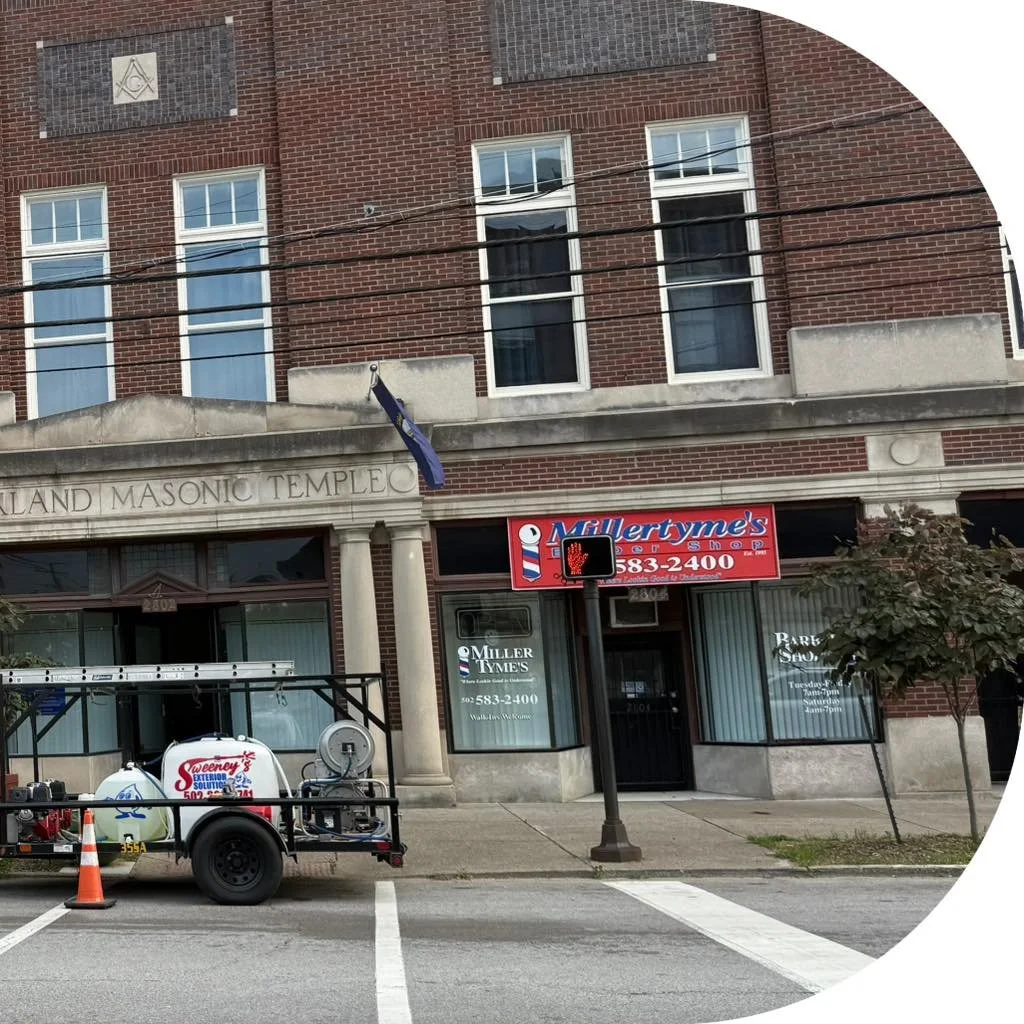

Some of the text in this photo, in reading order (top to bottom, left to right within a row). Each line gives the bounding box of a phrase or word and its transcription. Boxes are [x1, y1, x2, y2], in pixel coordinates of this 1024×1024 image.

[111, 480, 252, 510] MASONIC
[267, 467, 387, 500] TEMPLE
[547, 510, 769, 546] Millertyme's
[616, 554, 735, 574] 583-2400
[470, 645, 534, 659] MILLER
[778, 649, 819, 664] SHO
[475, 659, 529, 674] TYME'S
[475, 694, 538, 706] 583-2400
[175, 757, 252, 792] Sweeney's
[193, 773, 227, 782] EXTERIOR
